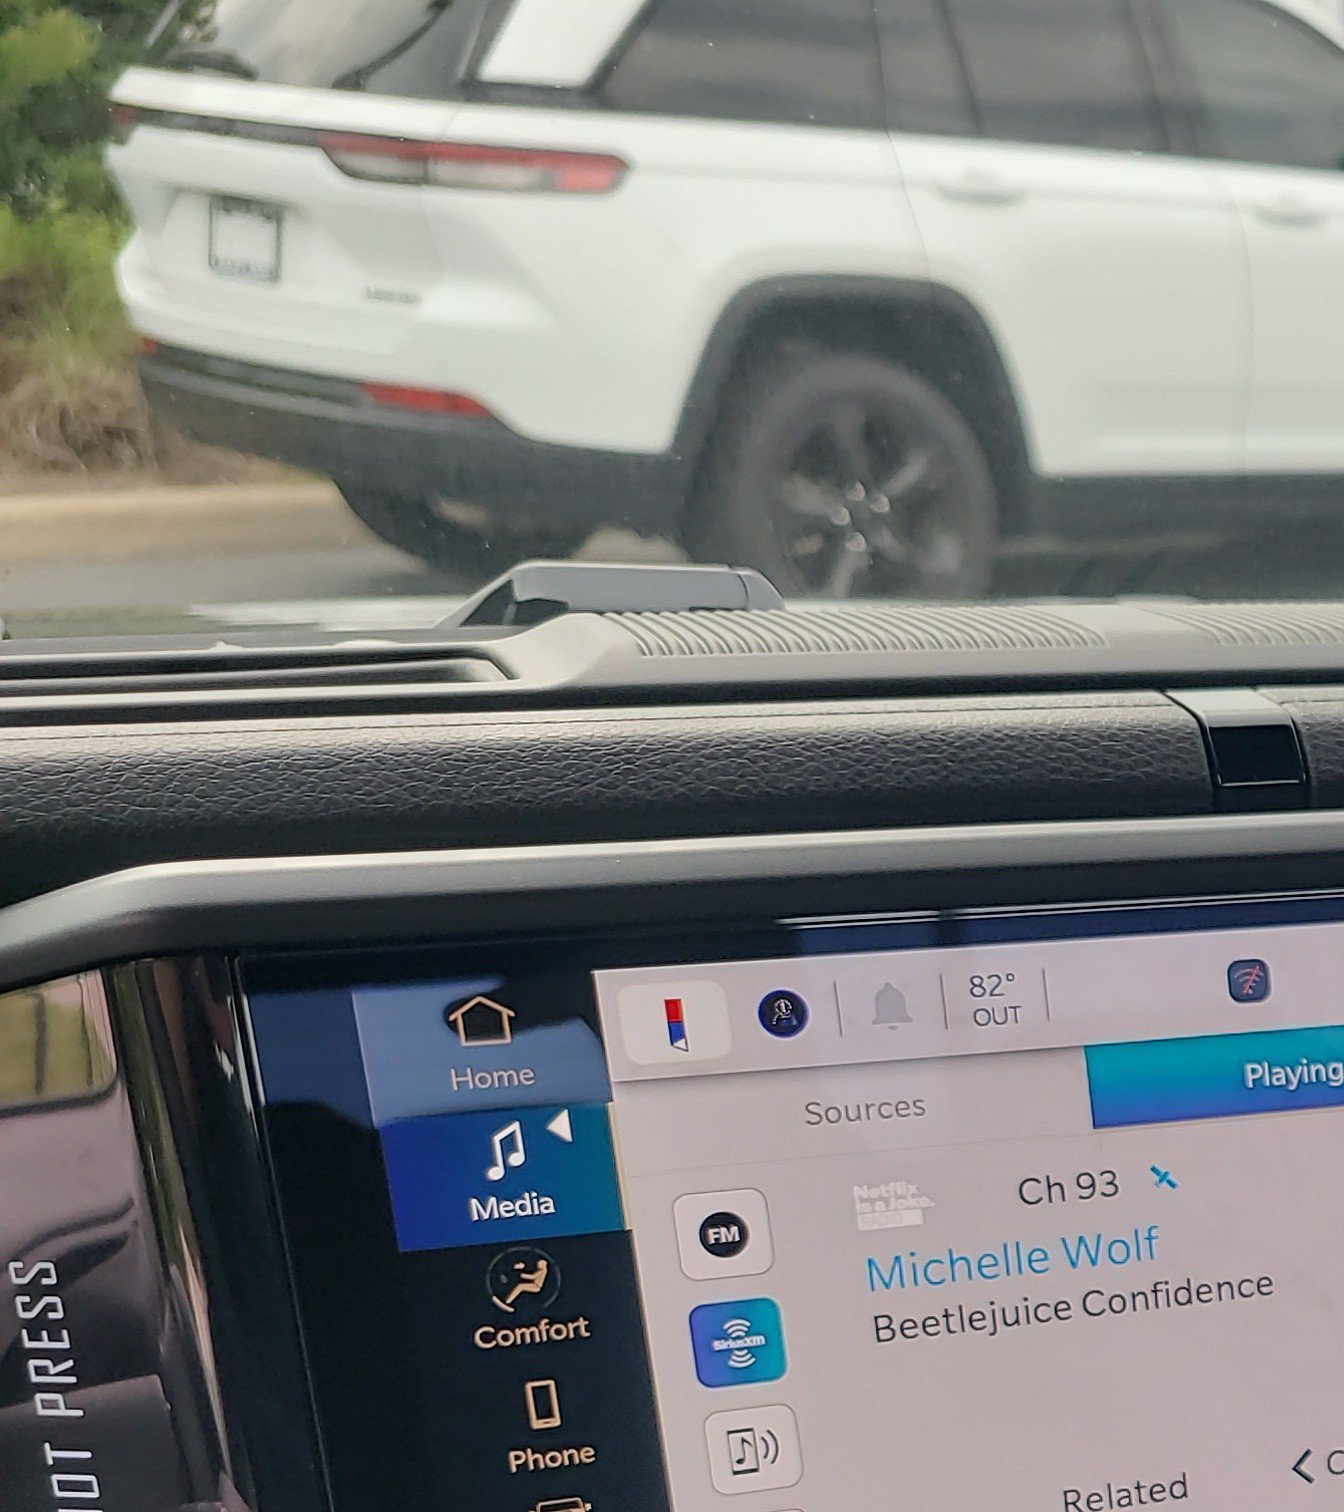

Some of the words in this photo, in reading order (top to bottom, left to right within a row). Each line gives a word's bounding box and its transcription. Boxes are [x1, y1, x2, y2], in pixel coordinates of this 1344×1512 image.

[973, 1005, 1022, 1027] OUT
[450, 1067, 536, 1091] Home
[804, 1096, 928, 1127] Sources
[1018, 1174, 1067, 1205] Ch
[1076, 1169, 1120, 1200] 93
[470, 1191, 556, 1221] Media
[706, 1226, 742, 1246] FM
[867, 1240, 1051, 1293] Michelle
[1060, 1224, 1160, 1270] Wolf
[873, 1296, 1074, 1344] Beetlejuice
[1082, 1275, 1275, 1317] Confidence
[9, 1261, 84, 1418] PRESS
[474, 1316, 592, 1349] Comfort
[508, 1446, 597, 1474] Phone
